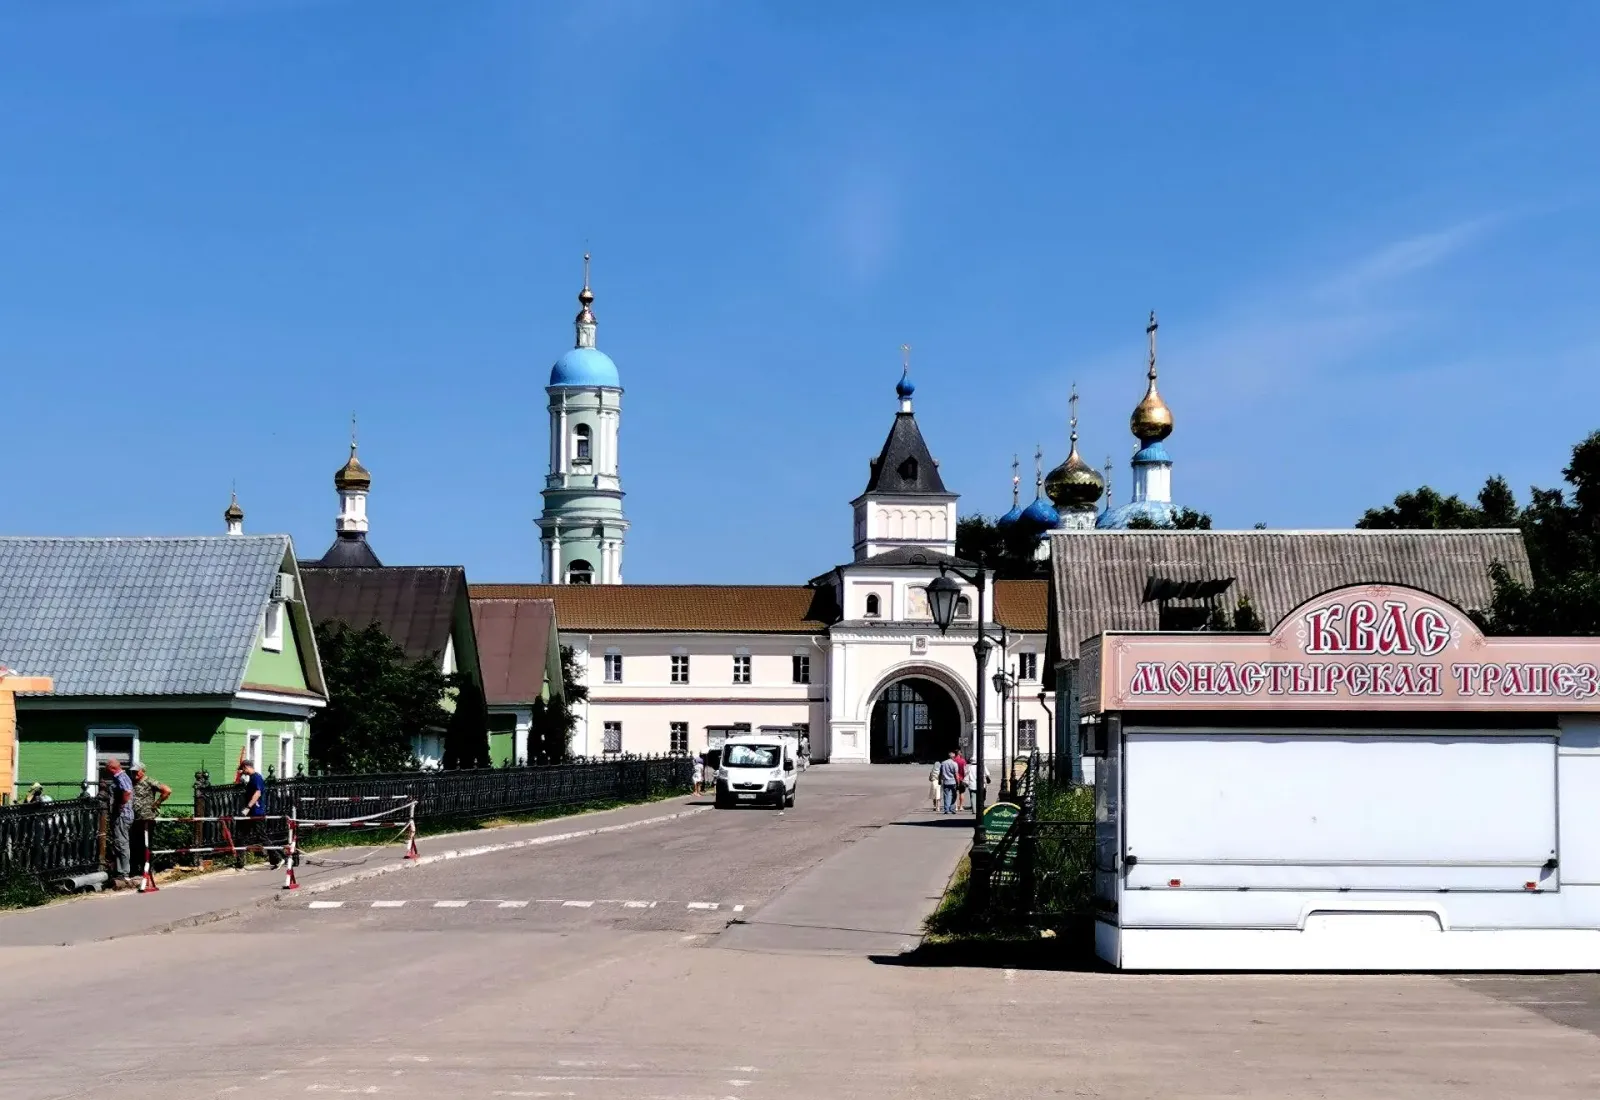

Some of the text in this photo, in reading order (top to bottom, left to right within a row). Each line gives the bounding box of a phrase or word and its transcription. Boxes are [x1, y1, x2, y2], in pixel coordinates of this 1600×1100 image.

[1304, 601, 1451, 656] КВАС
[1131, 662, 1600, 699] МОНАСТЫРСКАЯ ТРАПЕЗ
